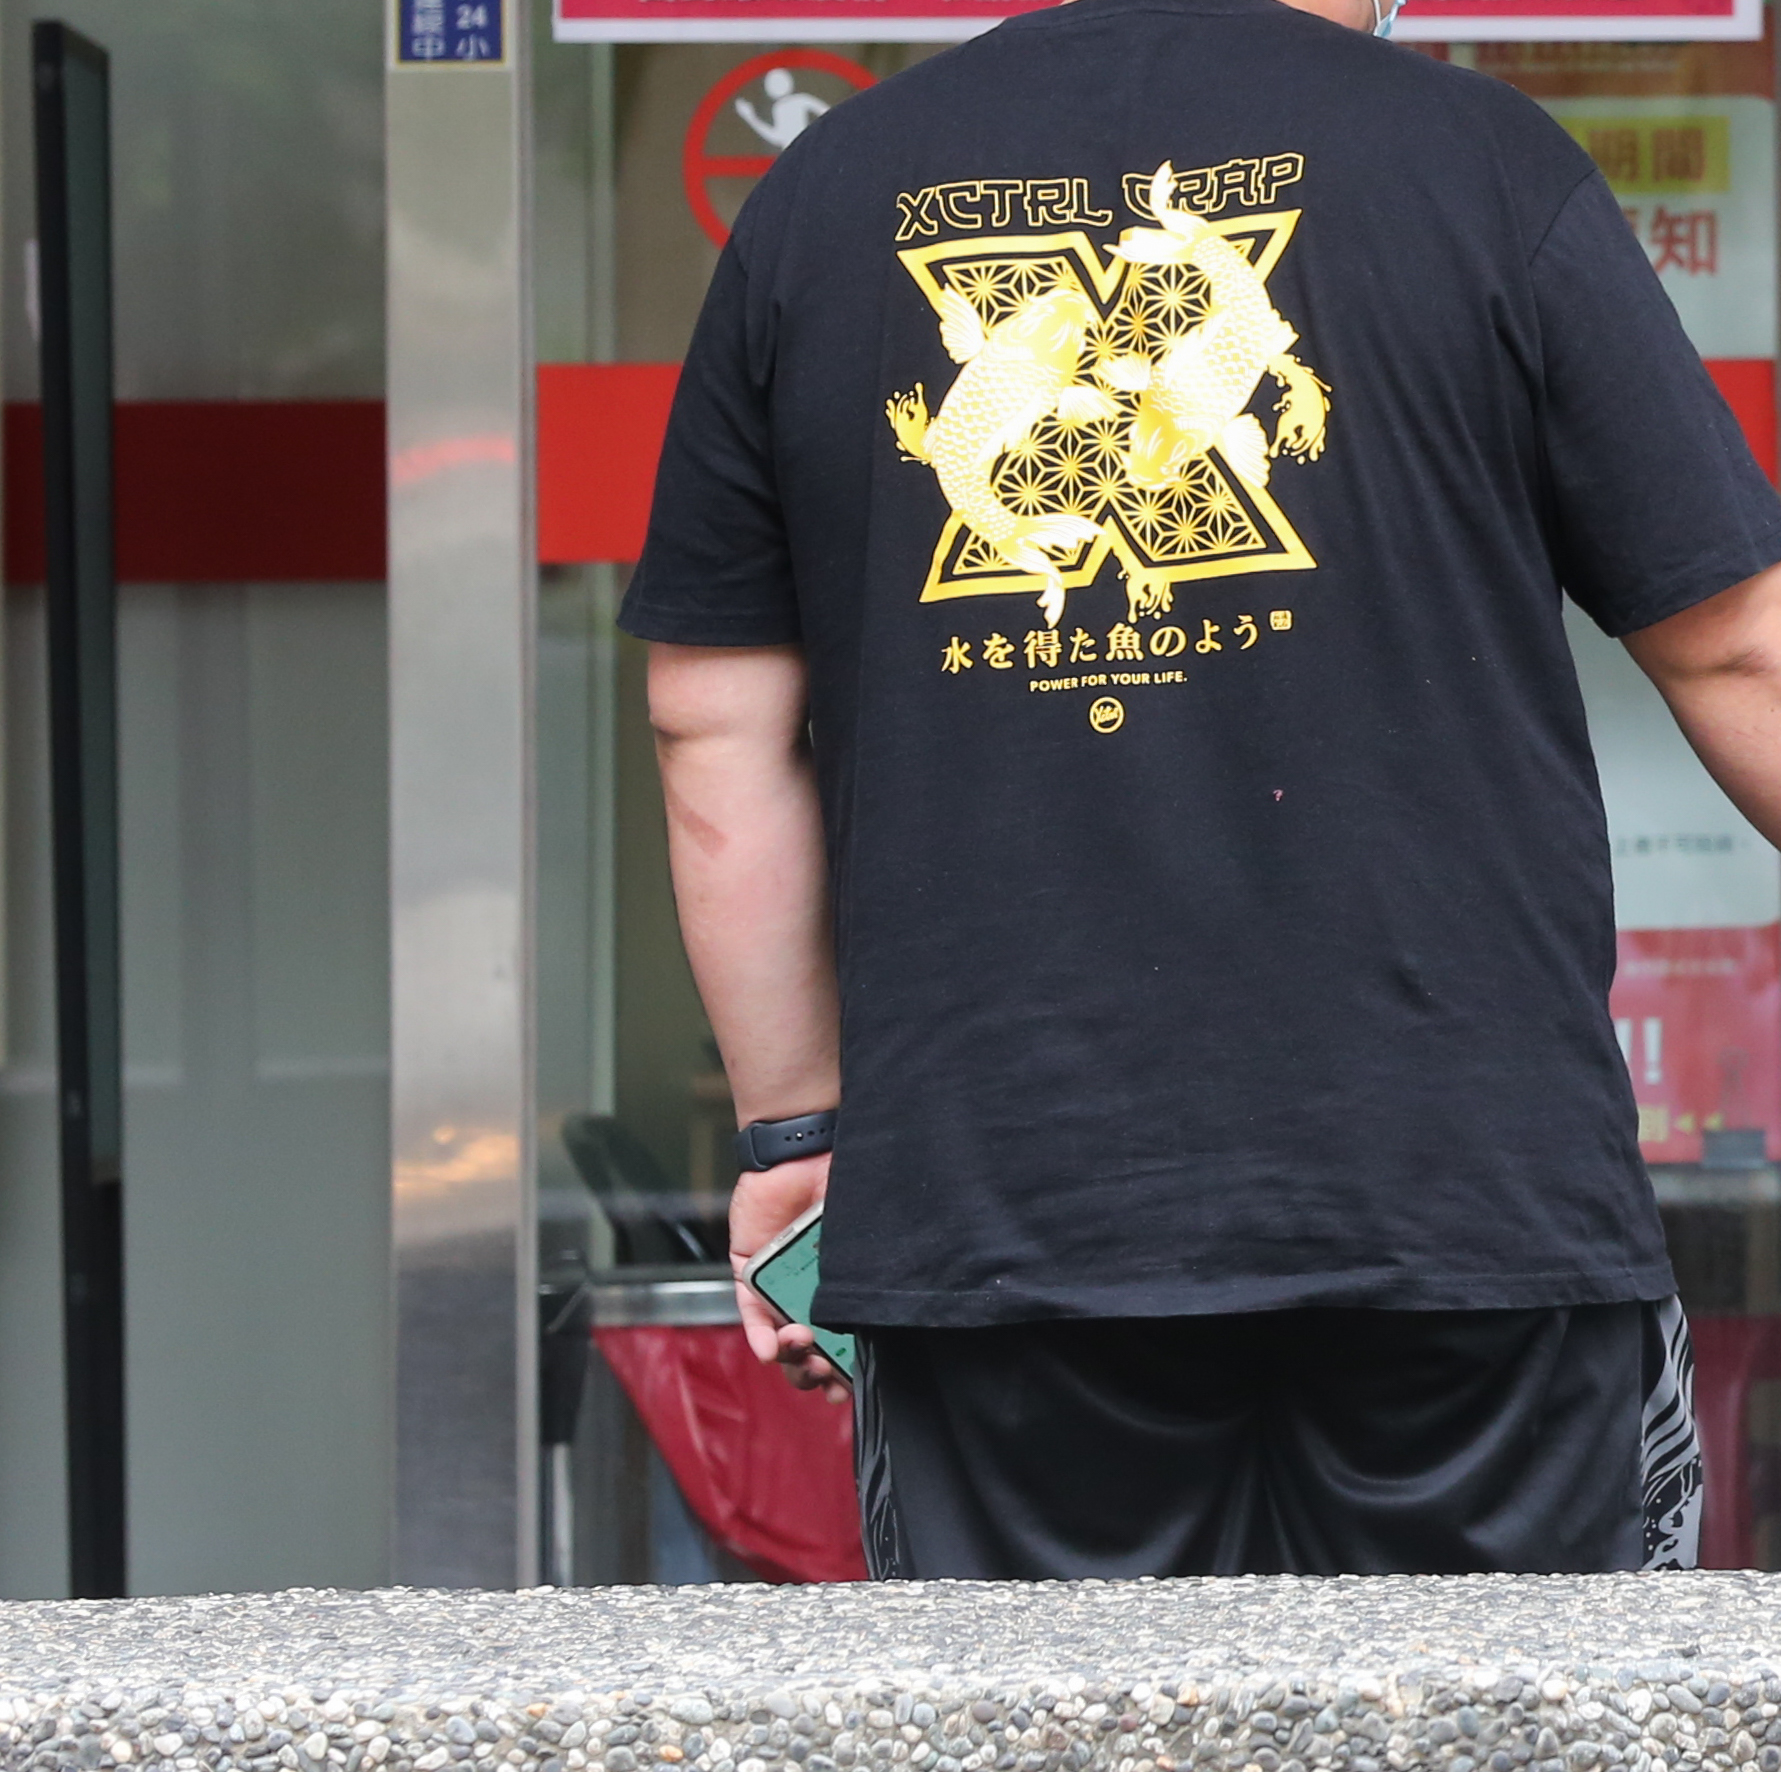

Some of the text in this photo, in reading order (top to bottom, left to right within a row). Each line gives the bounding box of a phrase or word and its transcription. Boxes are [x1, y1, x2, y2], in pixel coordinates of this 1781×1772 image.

[895, 177, 1113, 242] XCTRL
[941, 614, 1259, 675] 水を得た魚のよう
[1029, 670, 1188, 693] POWER FOR YOUR LIFE.
